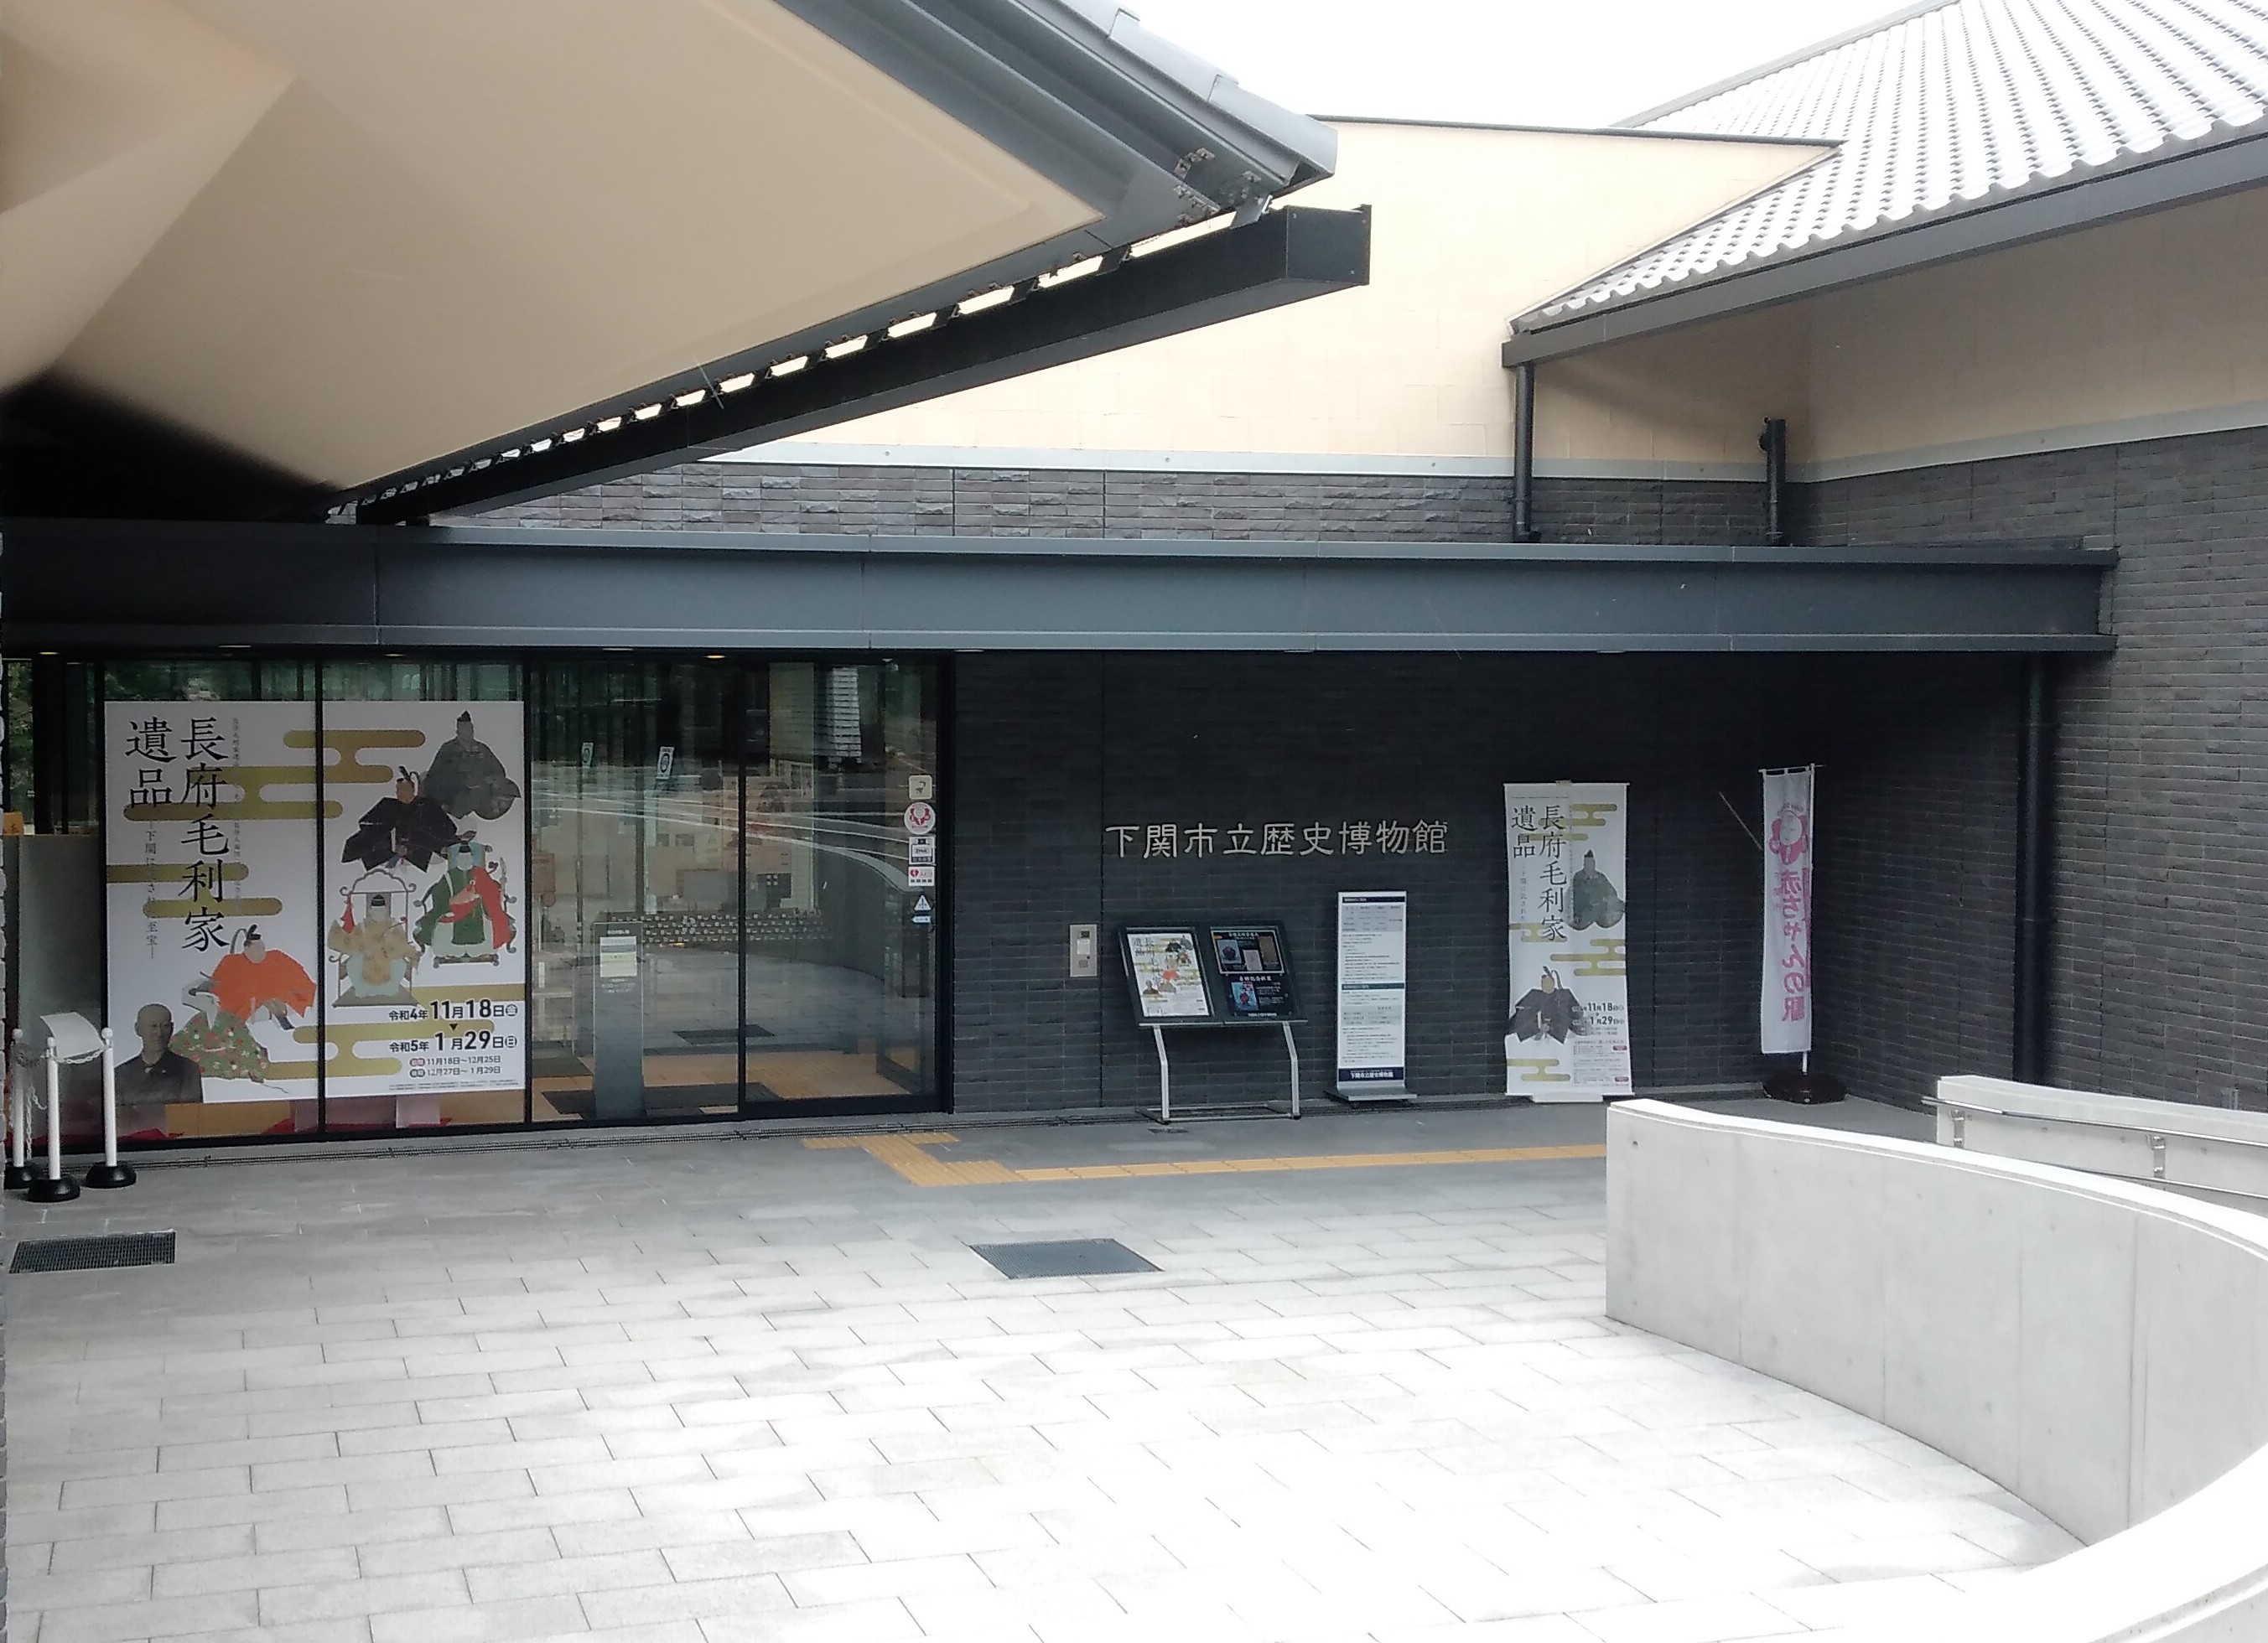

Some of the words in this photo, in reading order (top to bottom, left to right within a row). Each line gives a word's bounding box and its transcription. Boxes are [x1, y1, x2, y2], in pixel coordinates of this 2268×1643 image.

[125, 716, 177, 808] 遺品
[179, 717, 229, 951] 長府毛利家
[1104, 819, 1448, 858] 下関市立歴史博物館
[1511, 805, 1538, 858] 遺品
[1538, 805, 1568, 941] 長府毛利家
